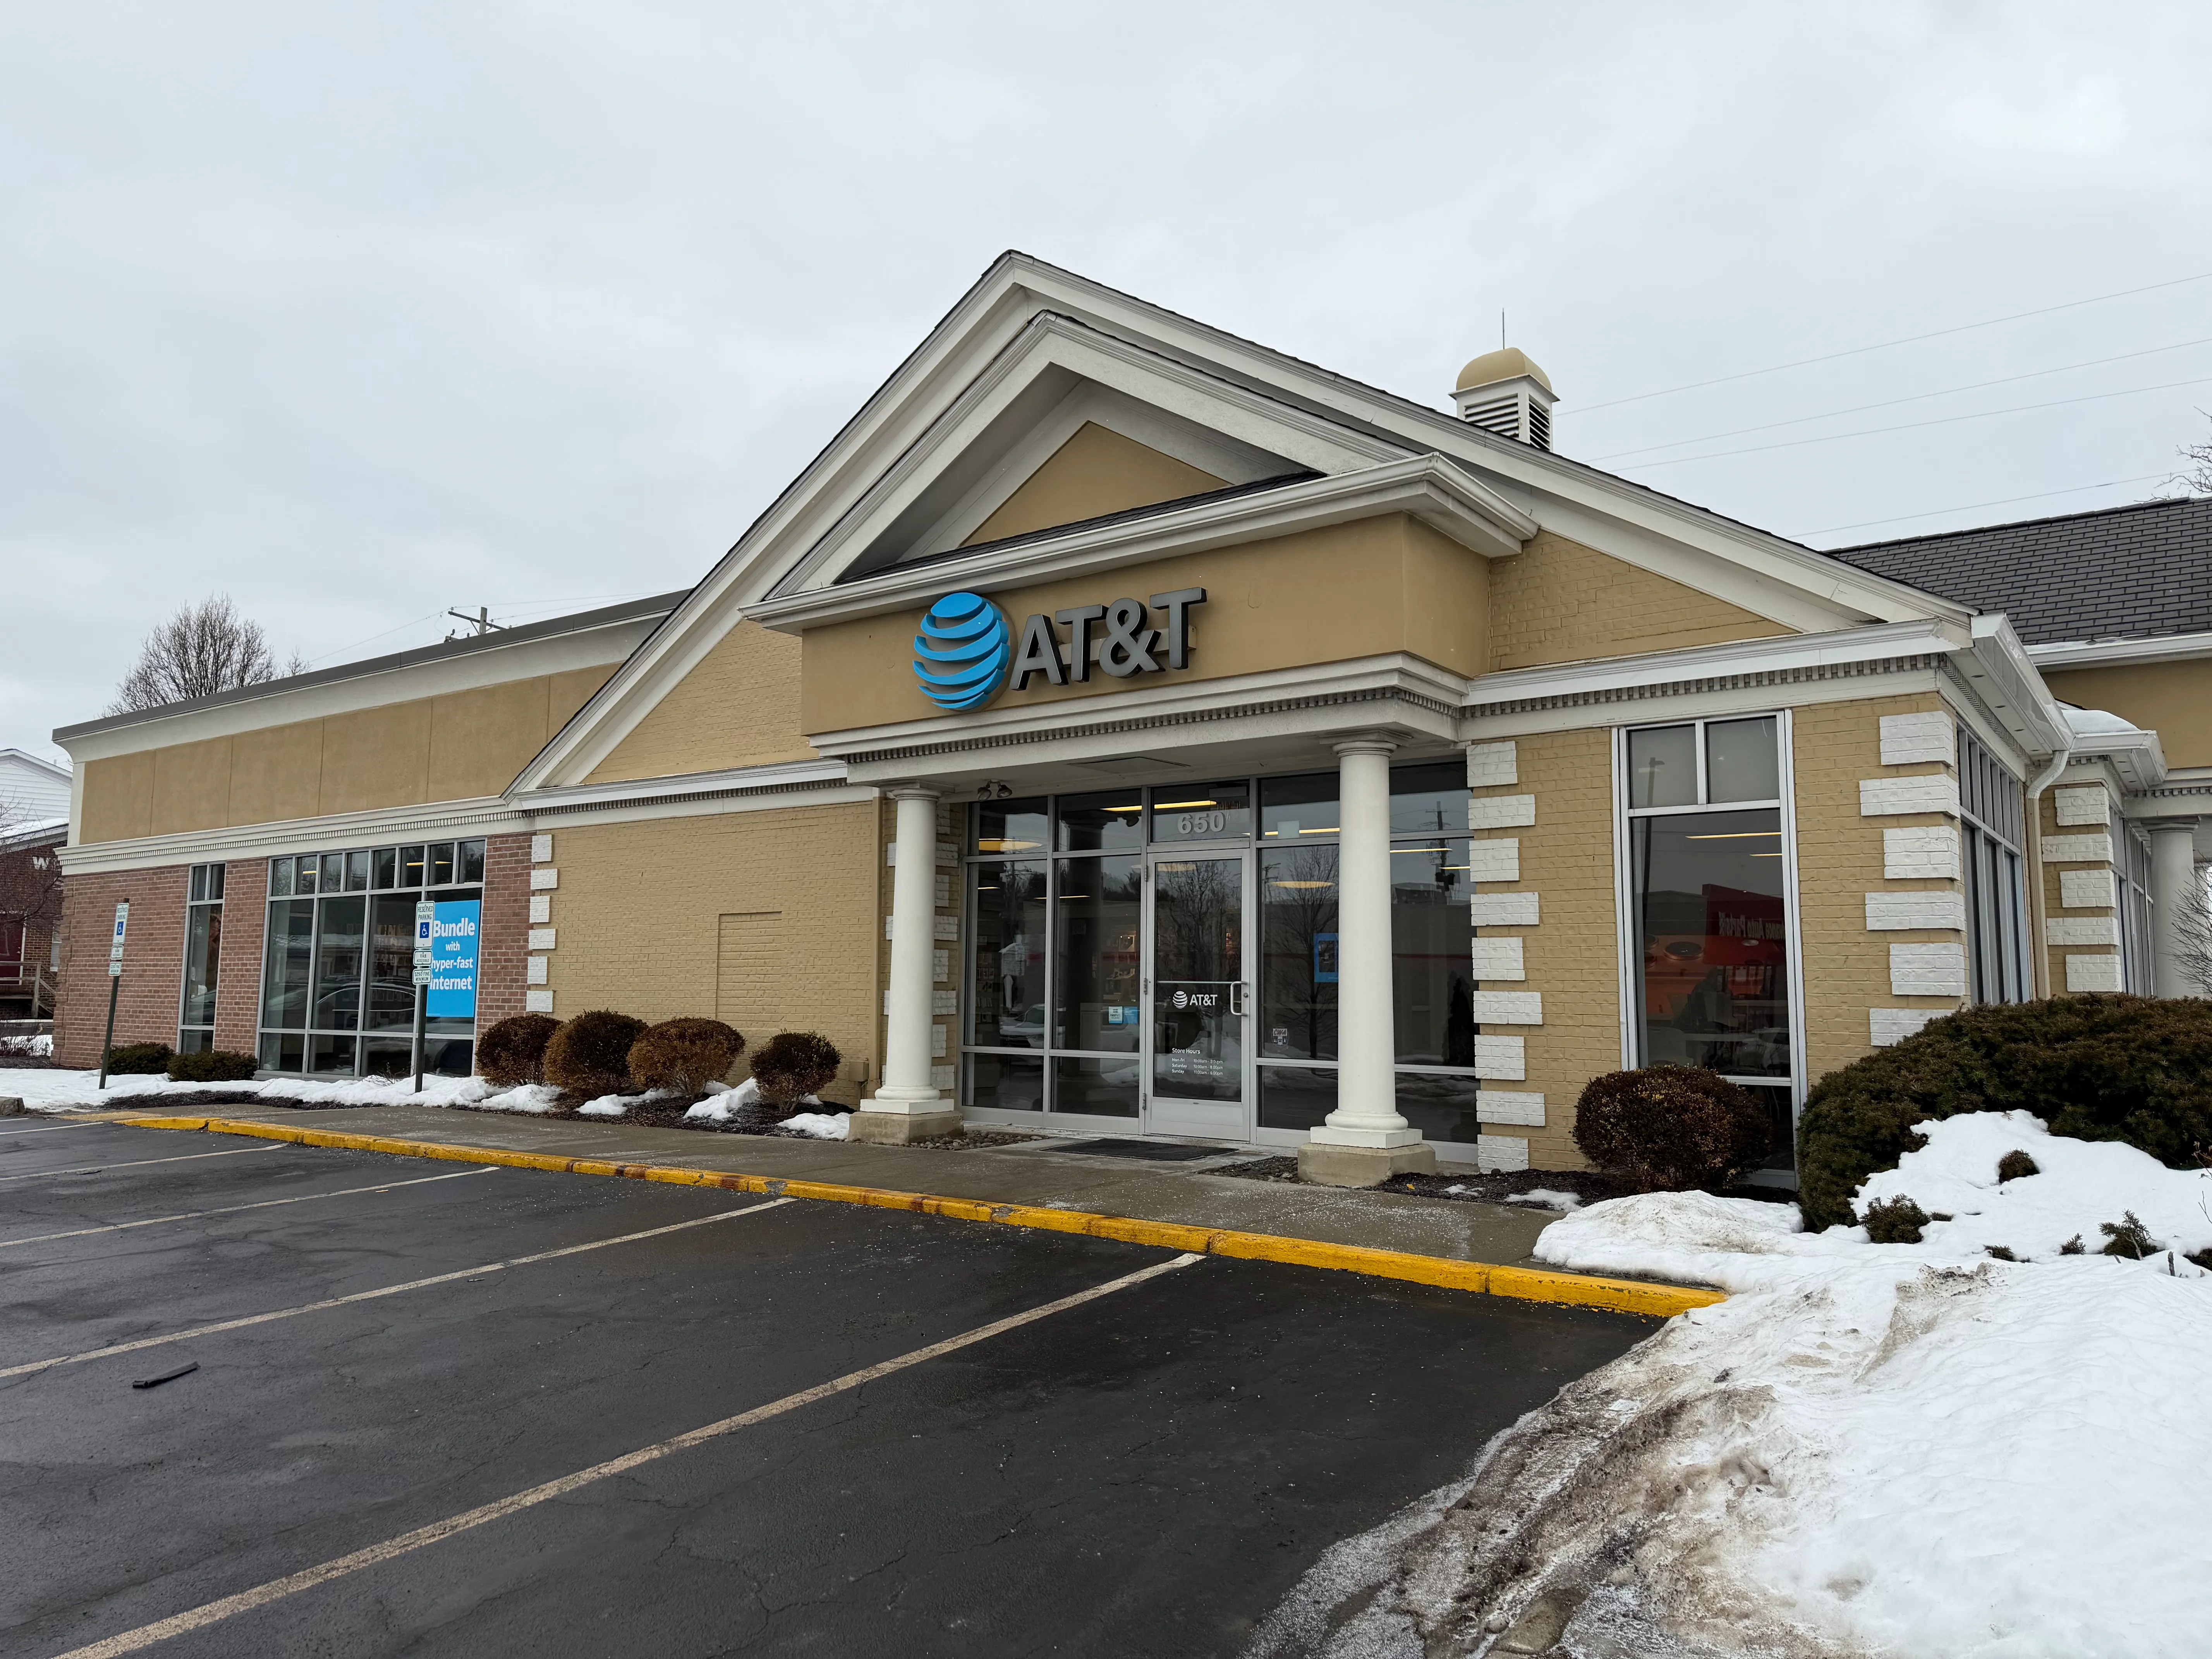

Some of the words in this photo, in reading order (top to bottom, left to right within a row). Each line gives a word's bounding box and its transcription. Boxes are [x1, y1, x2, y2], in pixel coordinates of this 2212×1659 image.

[1009, 587, 1207, 691] AT&T
[1178, 812, 1225, 834] 650
[433, 918, 475, 937] Bundle
[446, 941, 460, 951] with
[431, 956, 473, 972] hyper-fast
[430, 975, 472, 990] internet
[1190, 994, 1218, 1006] AT&T
